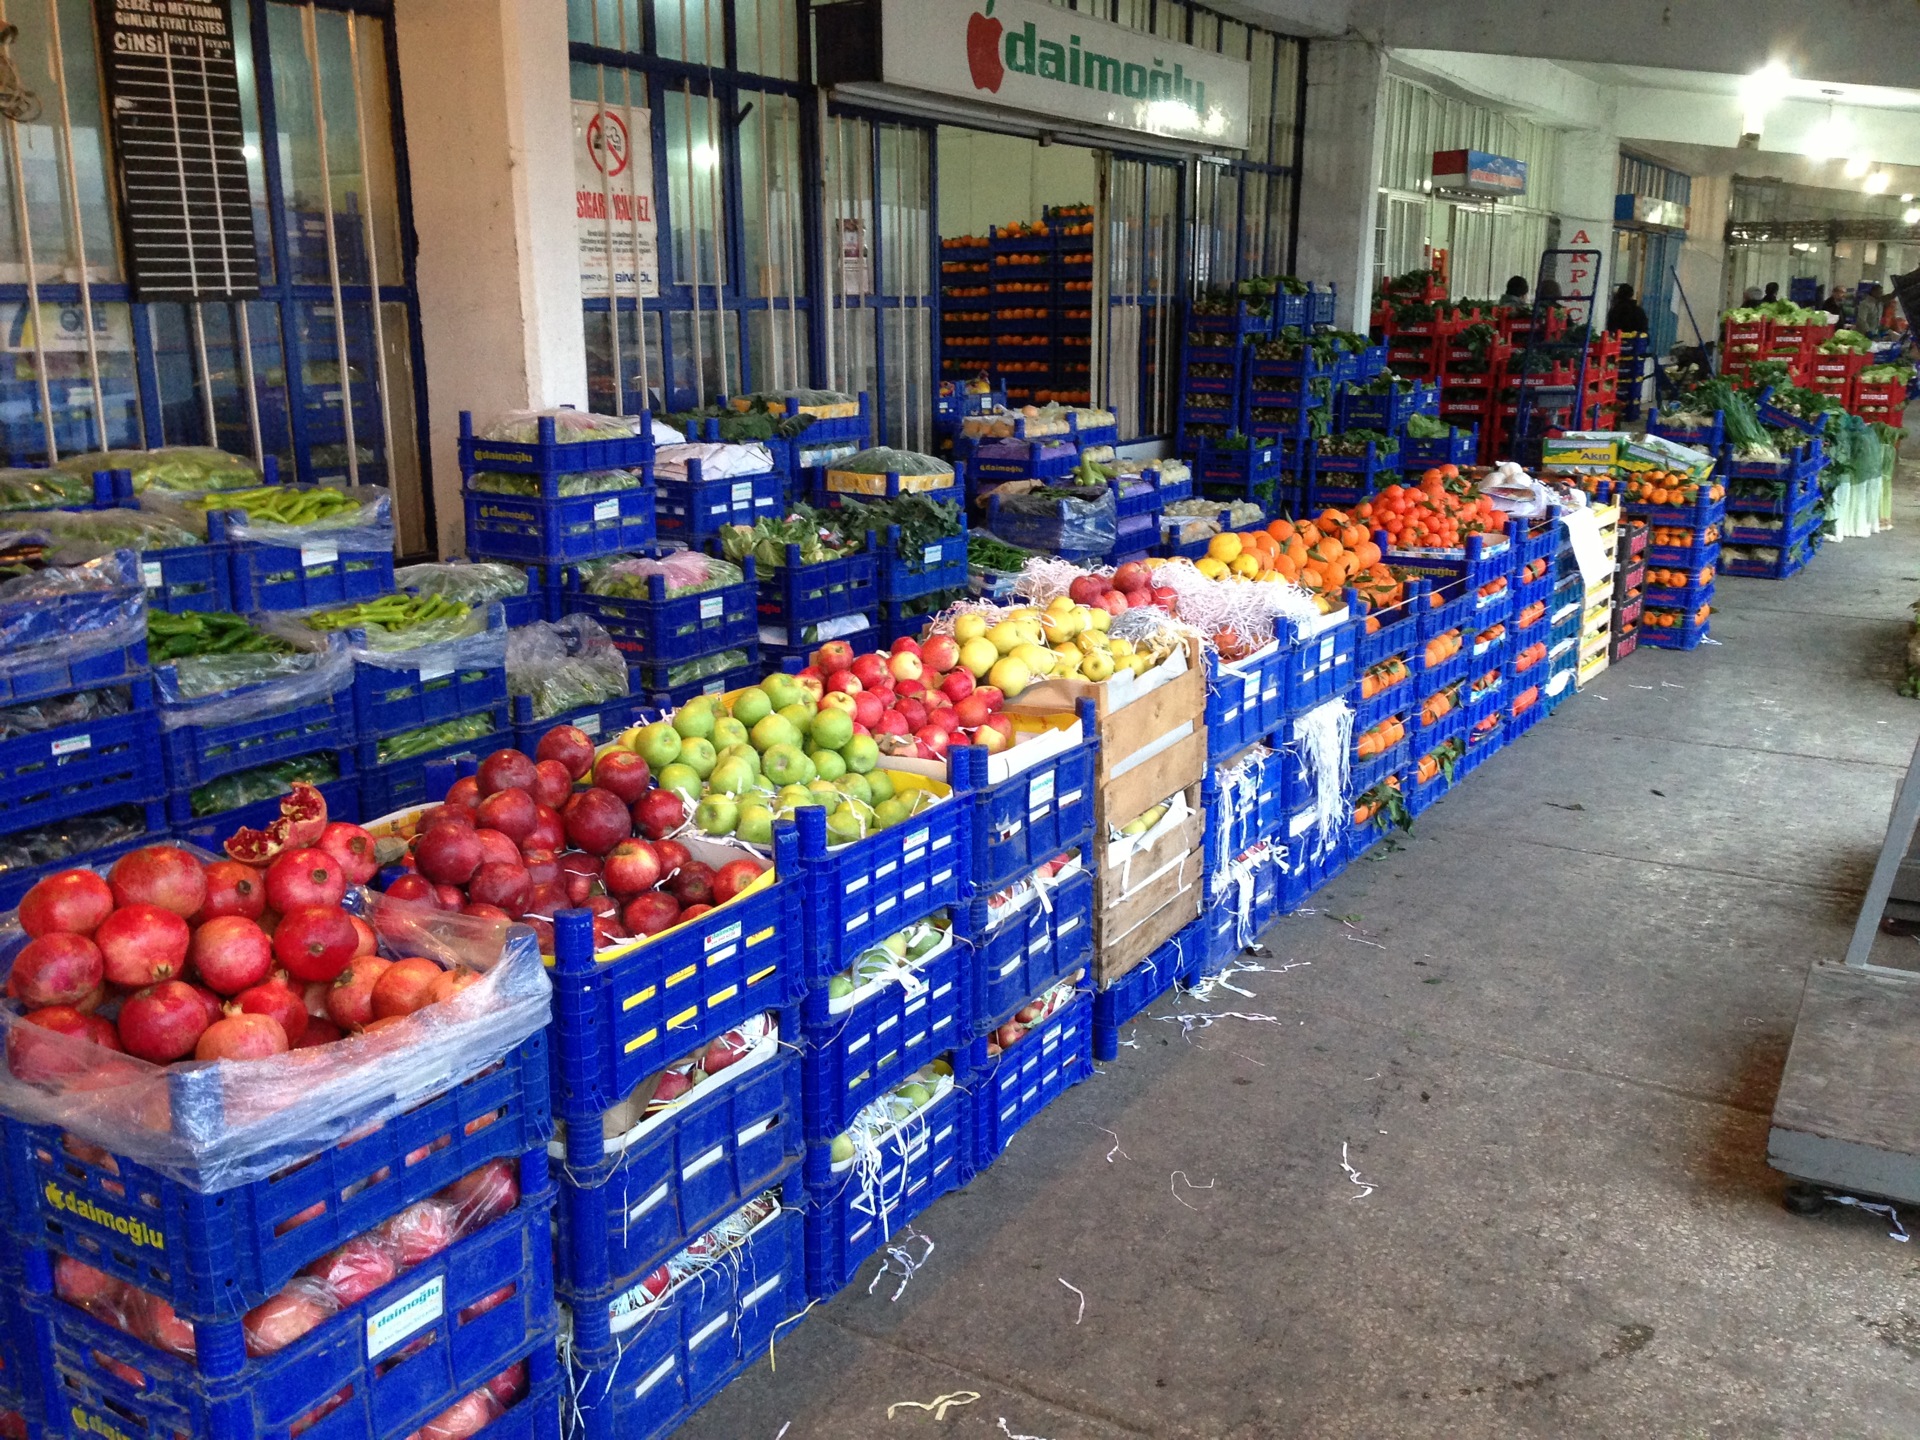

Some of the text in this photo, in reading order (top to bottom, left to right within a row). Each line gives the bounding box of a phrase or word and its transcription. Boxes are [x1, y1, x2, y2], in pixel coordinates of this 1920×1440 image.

[153, 2, 167, 13] ve
[168, 1, 223, 20] MEYVANIN
[214, 50, 222, 59] 2
[1005, 21, 1205, 114] daimoğlu
[576, 184, 609, 219] SİGAR
[65, 1189, 165, 1251] daimoğlu
[377, 1285, 440, 1329] daimoğlu
